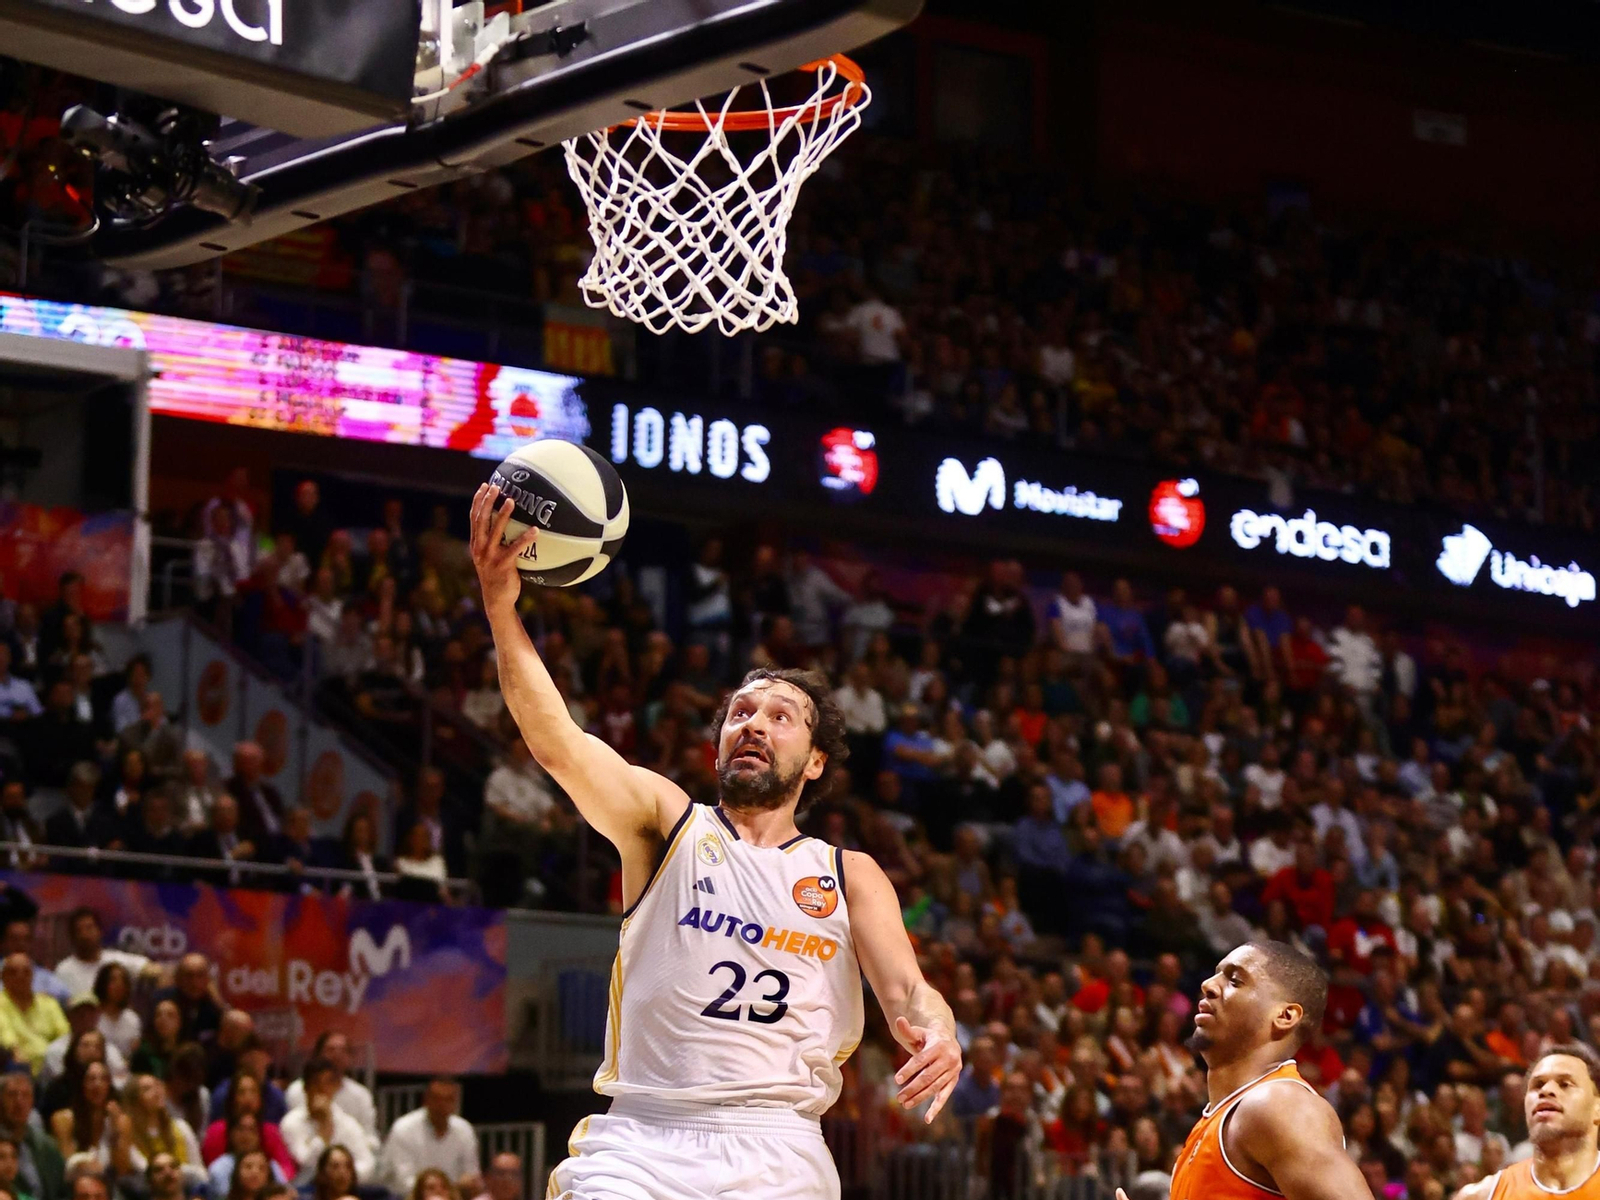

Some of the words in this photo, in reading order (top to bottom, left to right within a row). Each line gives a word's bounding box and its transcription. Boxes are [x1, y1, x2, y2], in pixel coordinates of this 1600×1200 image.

[611, 402, 771, 483] IONOS
[1014, 479, 1123, 522] Movistar
[1230, 508, 1391, 569] endesa
[678, 907, 838, 962] AUTOHERO
[288, 959, 369, 1014] Rey
[700, 960, 790, 1024] 23
